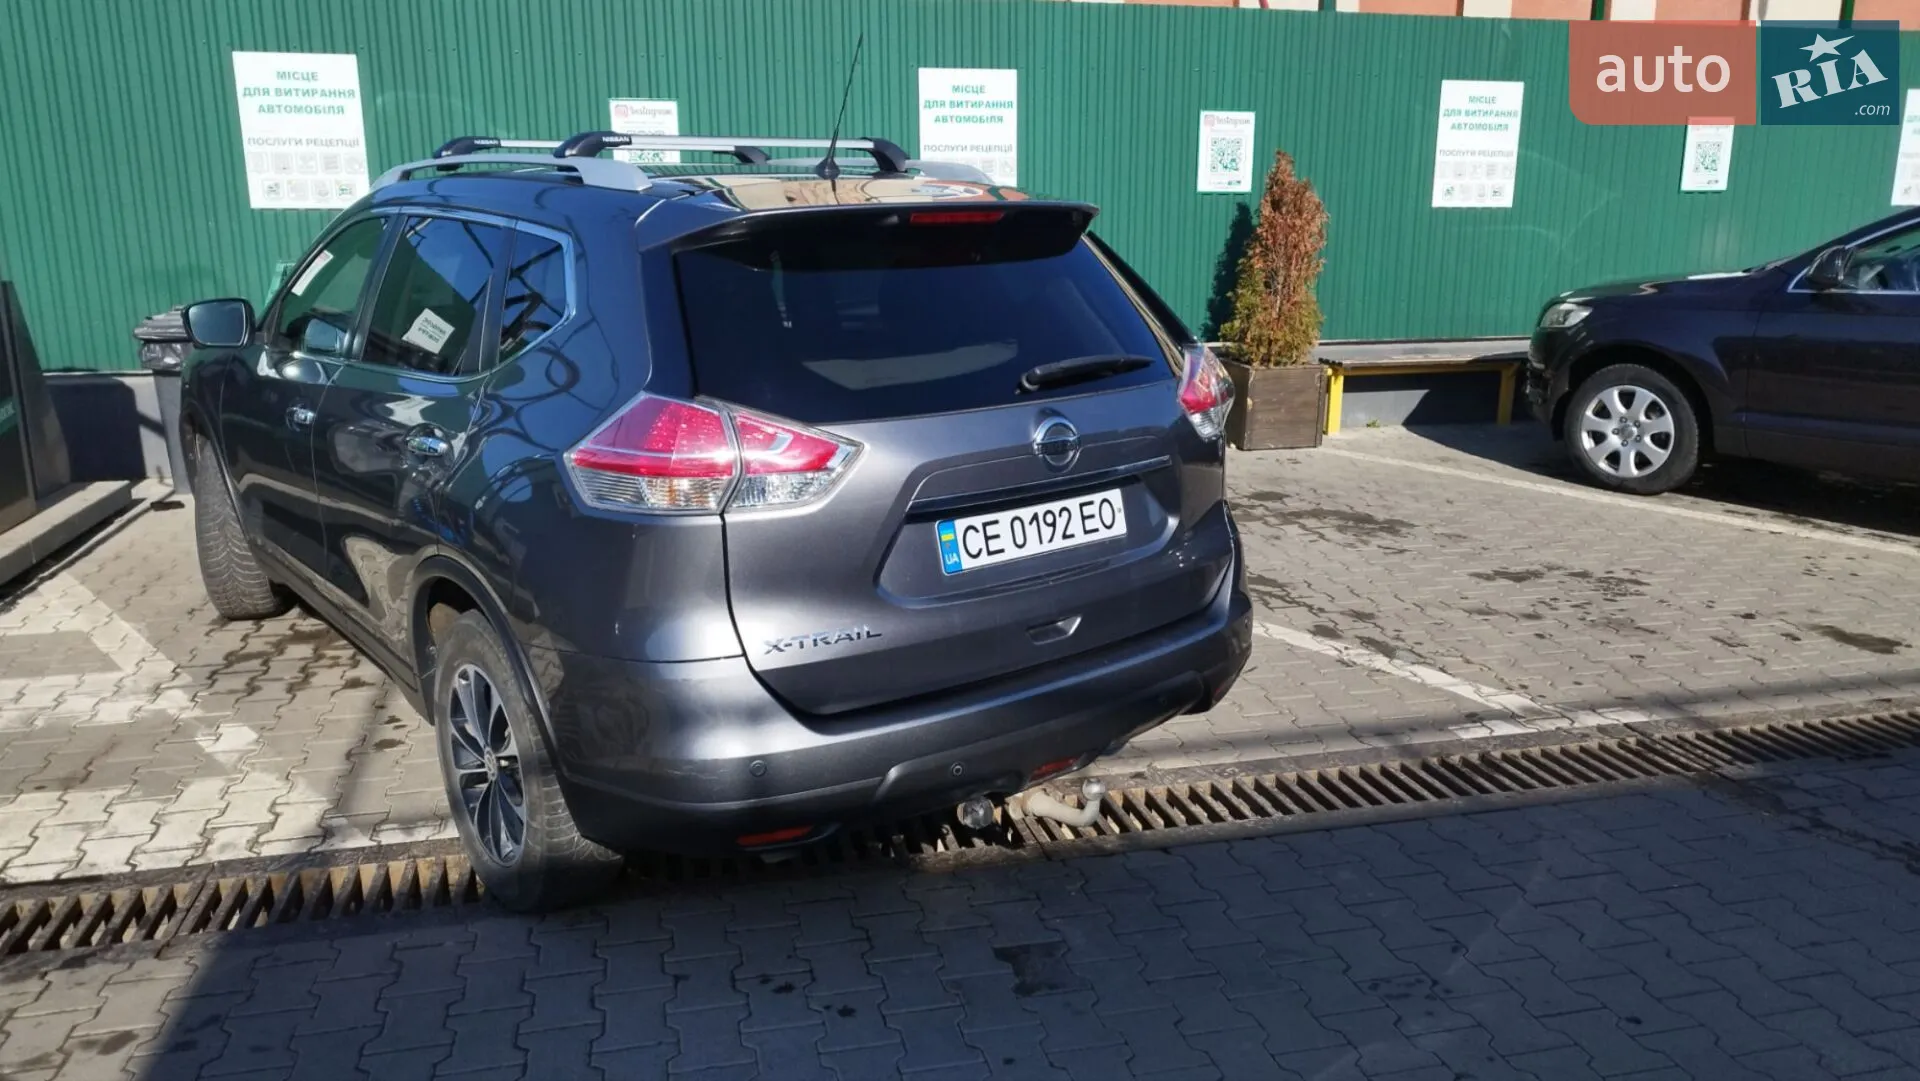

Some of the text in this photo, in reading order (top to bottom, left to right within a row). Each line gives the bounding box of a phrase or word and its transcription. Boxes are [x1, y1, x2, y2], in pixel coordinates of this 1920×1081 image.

[276, 71, 319, 82] МІСЦЕ
[242, 87, 356, 98] ДЛЯ ВИТИРАННЯ
[952, 84, 986, 95] МІСЦЕ
[258, 104, 345, 115] АВТОМОБІЛЯ
[923, 100, 1014, 110] ДЛЯ ВИТИРАННЯ
[934, 115, 1004, 124] АВТОМОБІЛЯ
[247, 137, 303, 147] ПОСЛУГИ
[923, 144, 968, 153] ПОСЛУГИ
[962, 498, 1117, 560] CE 0192 EO
[945, 553, 960, 566] UA
[763, 624, 883, 656] X-TRAIL
